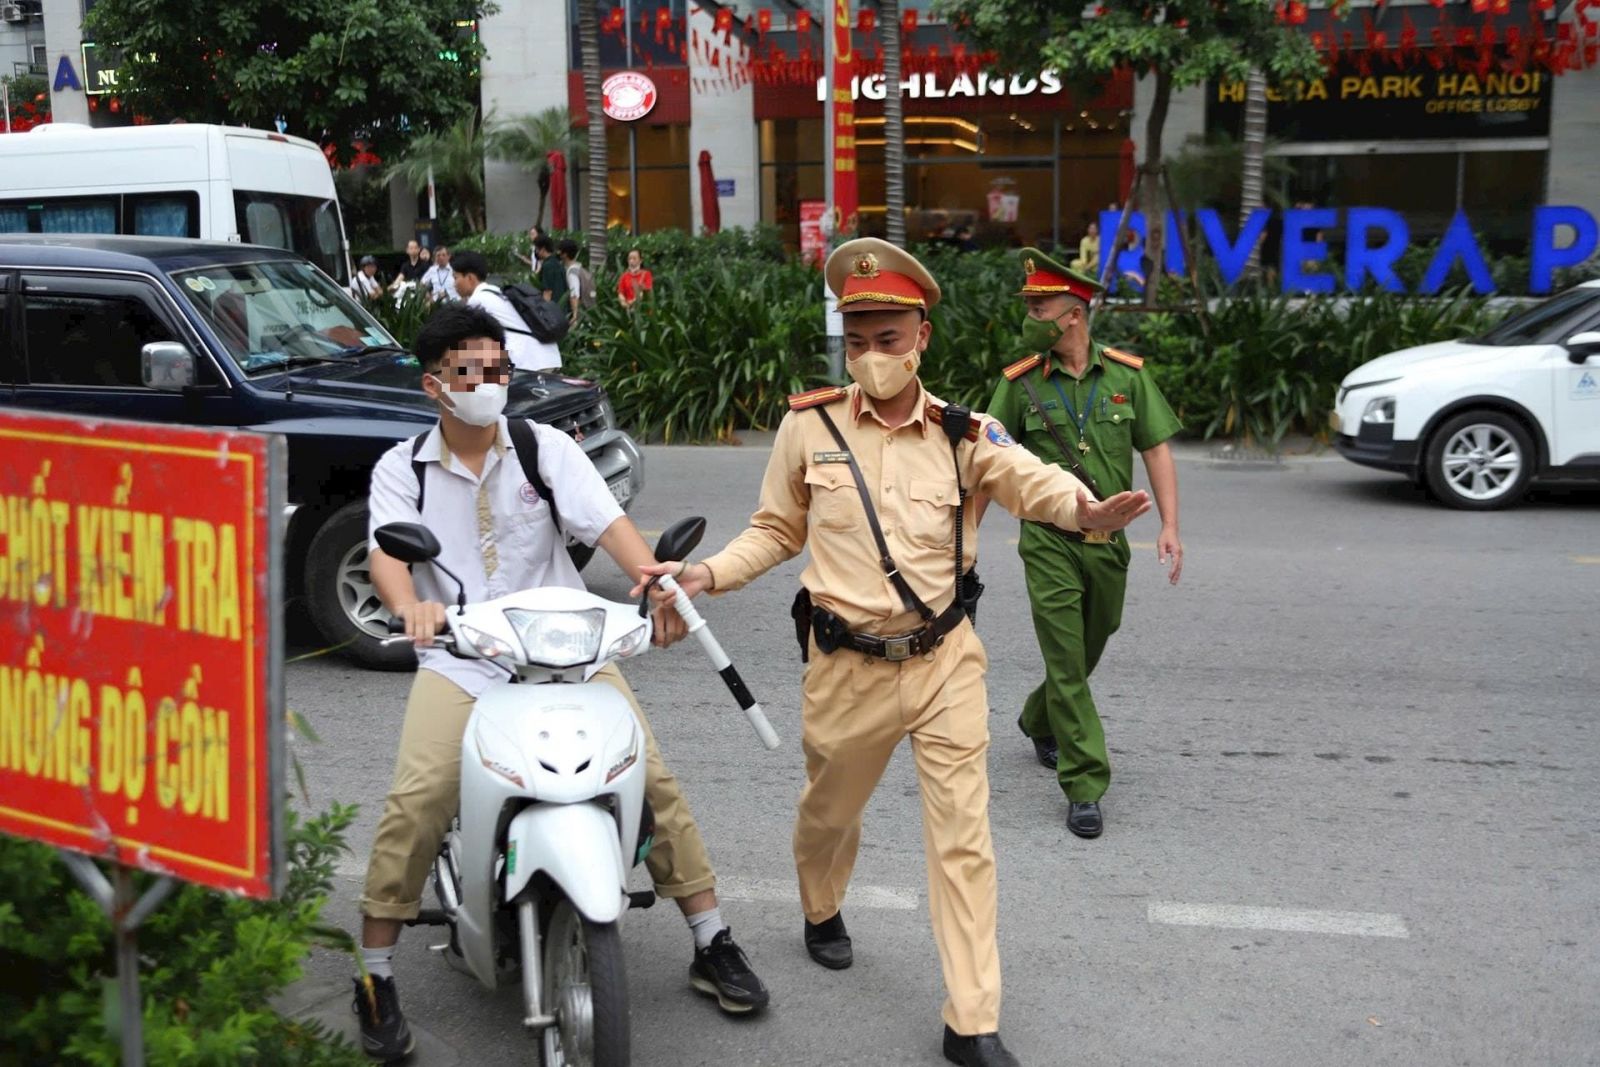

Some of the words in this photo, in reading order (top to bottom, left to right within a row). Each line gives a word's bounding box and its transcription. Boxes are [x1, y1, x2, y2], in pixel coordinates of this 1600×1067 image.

[53, 55, 82, 92] A
[1340, 74, 1424, 100] PARK
[1437, 70, 1541, 97] HANOI
[1425, 99, 1482, 114] OFFICE
[1486, 97, 1542, 112] LOBBY
[172, 516, 242, 642] TRA
